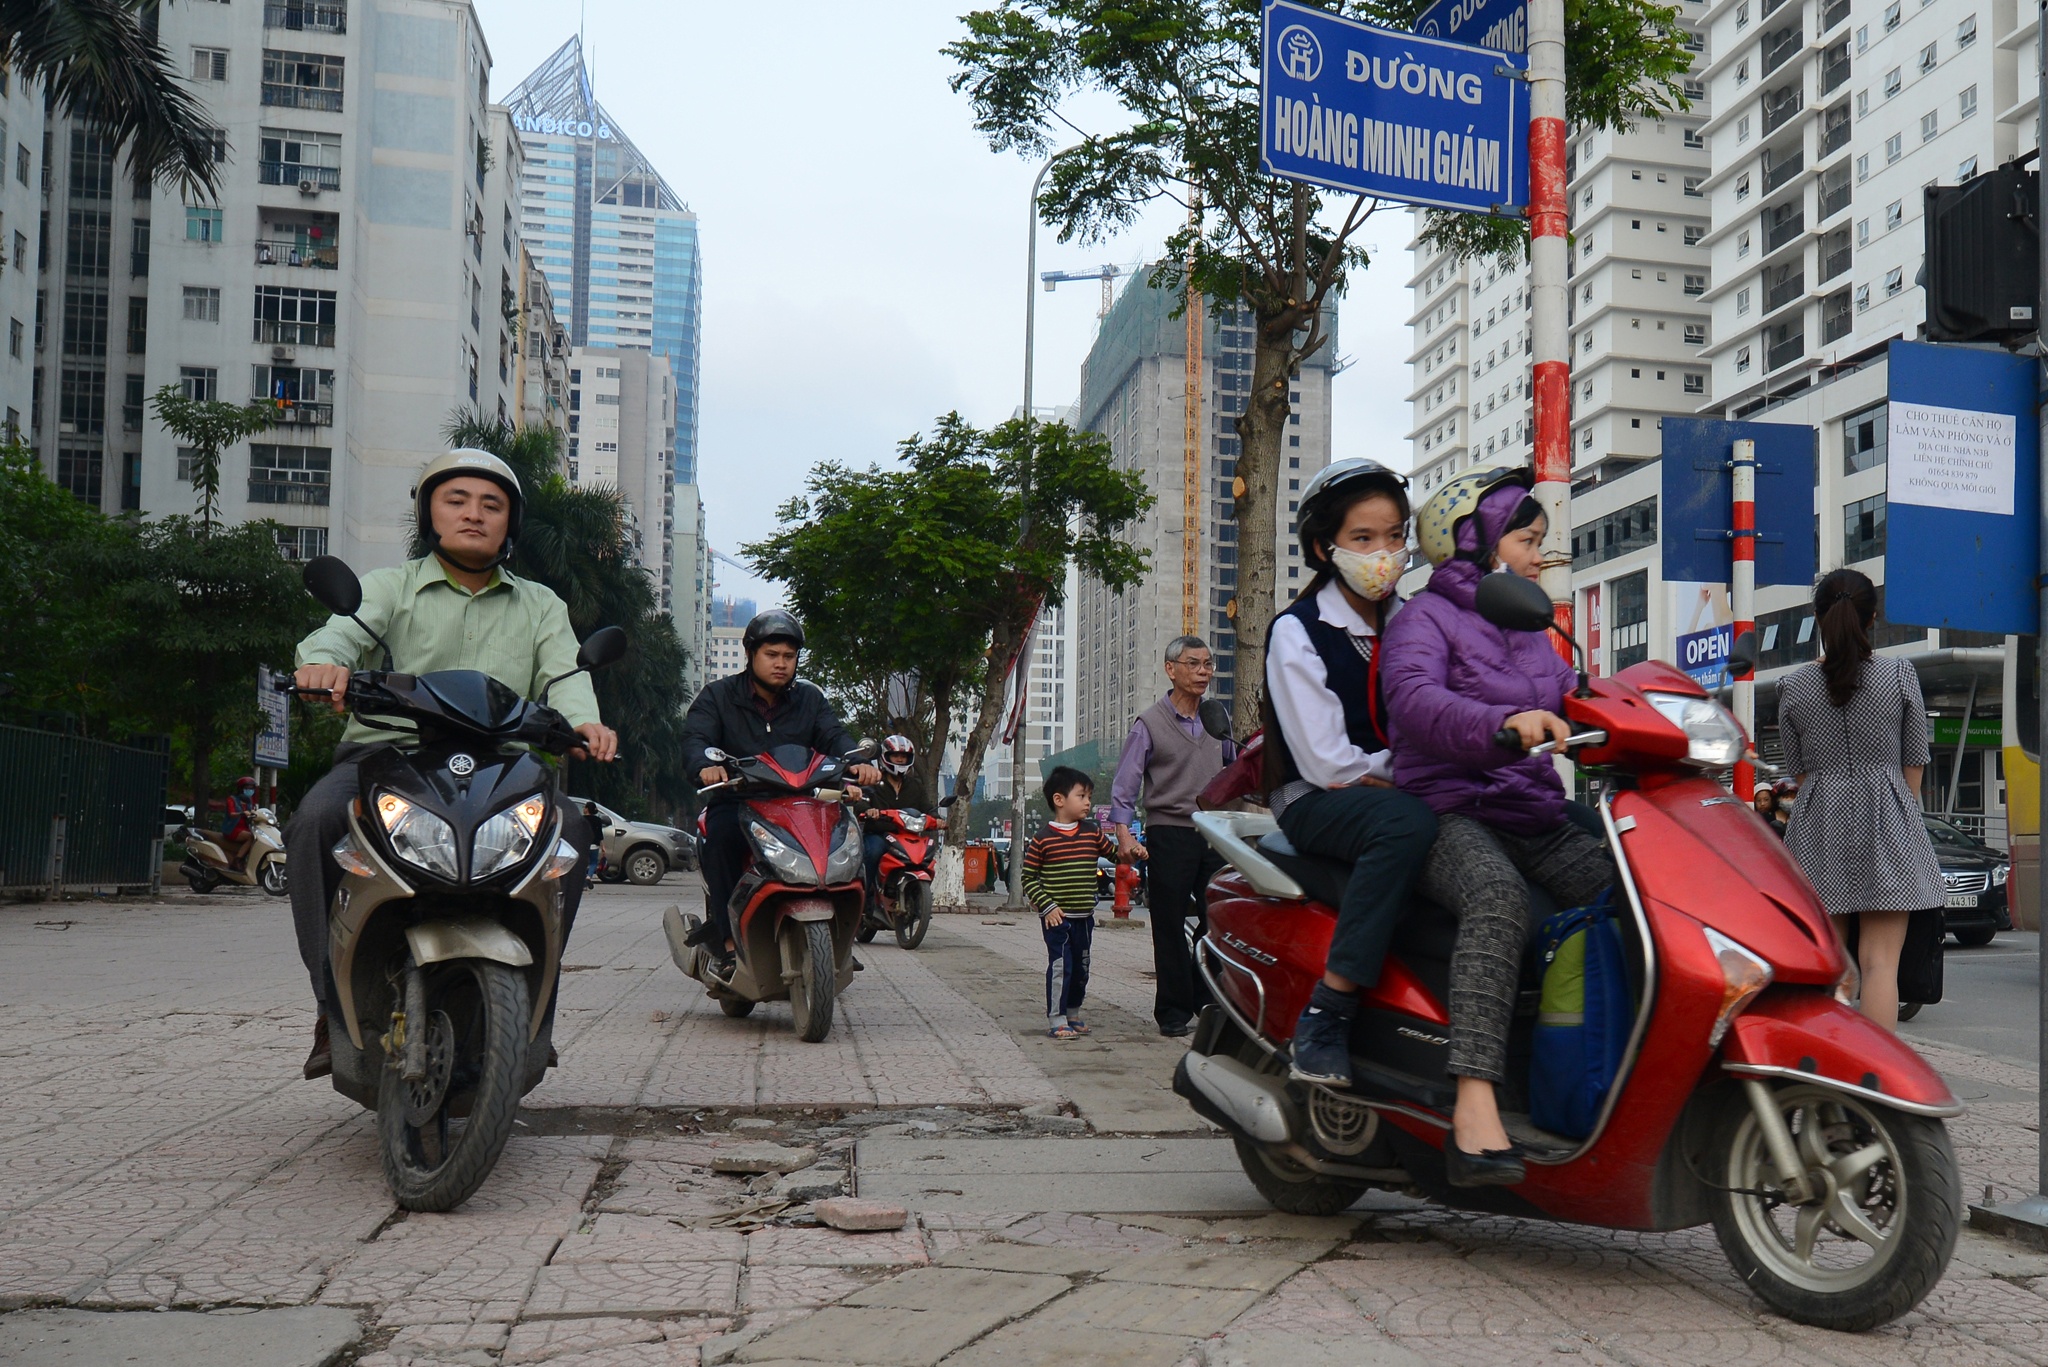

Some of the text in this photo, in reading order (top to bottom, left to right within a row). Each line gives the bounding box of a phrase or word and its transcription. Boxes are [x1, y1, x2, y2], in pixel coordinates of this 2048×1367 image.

[1345, 49, 1482, 105] ĐƯỜNG
[513, 115, 610, 139] ANDICO 6
[1275, 92, 1500, 193] HOÀNG MINH GIÁM
[1896, 422, 1919, 436] LÀM
[1947, 429, 1984, 444] PHÒNG
[1986, 433, 2001, 446] VÀ
[1906, 410, 1929, 421] CHO
[1986, 419, 2002, 432] HỘ
[1909, 477, 1940, 488] KHÔNG
[1940, 481, 1959, 491] QUA
[1686, 632, 1729, 664] OPEN
[1221, 931, 1278, 966] LEAD
